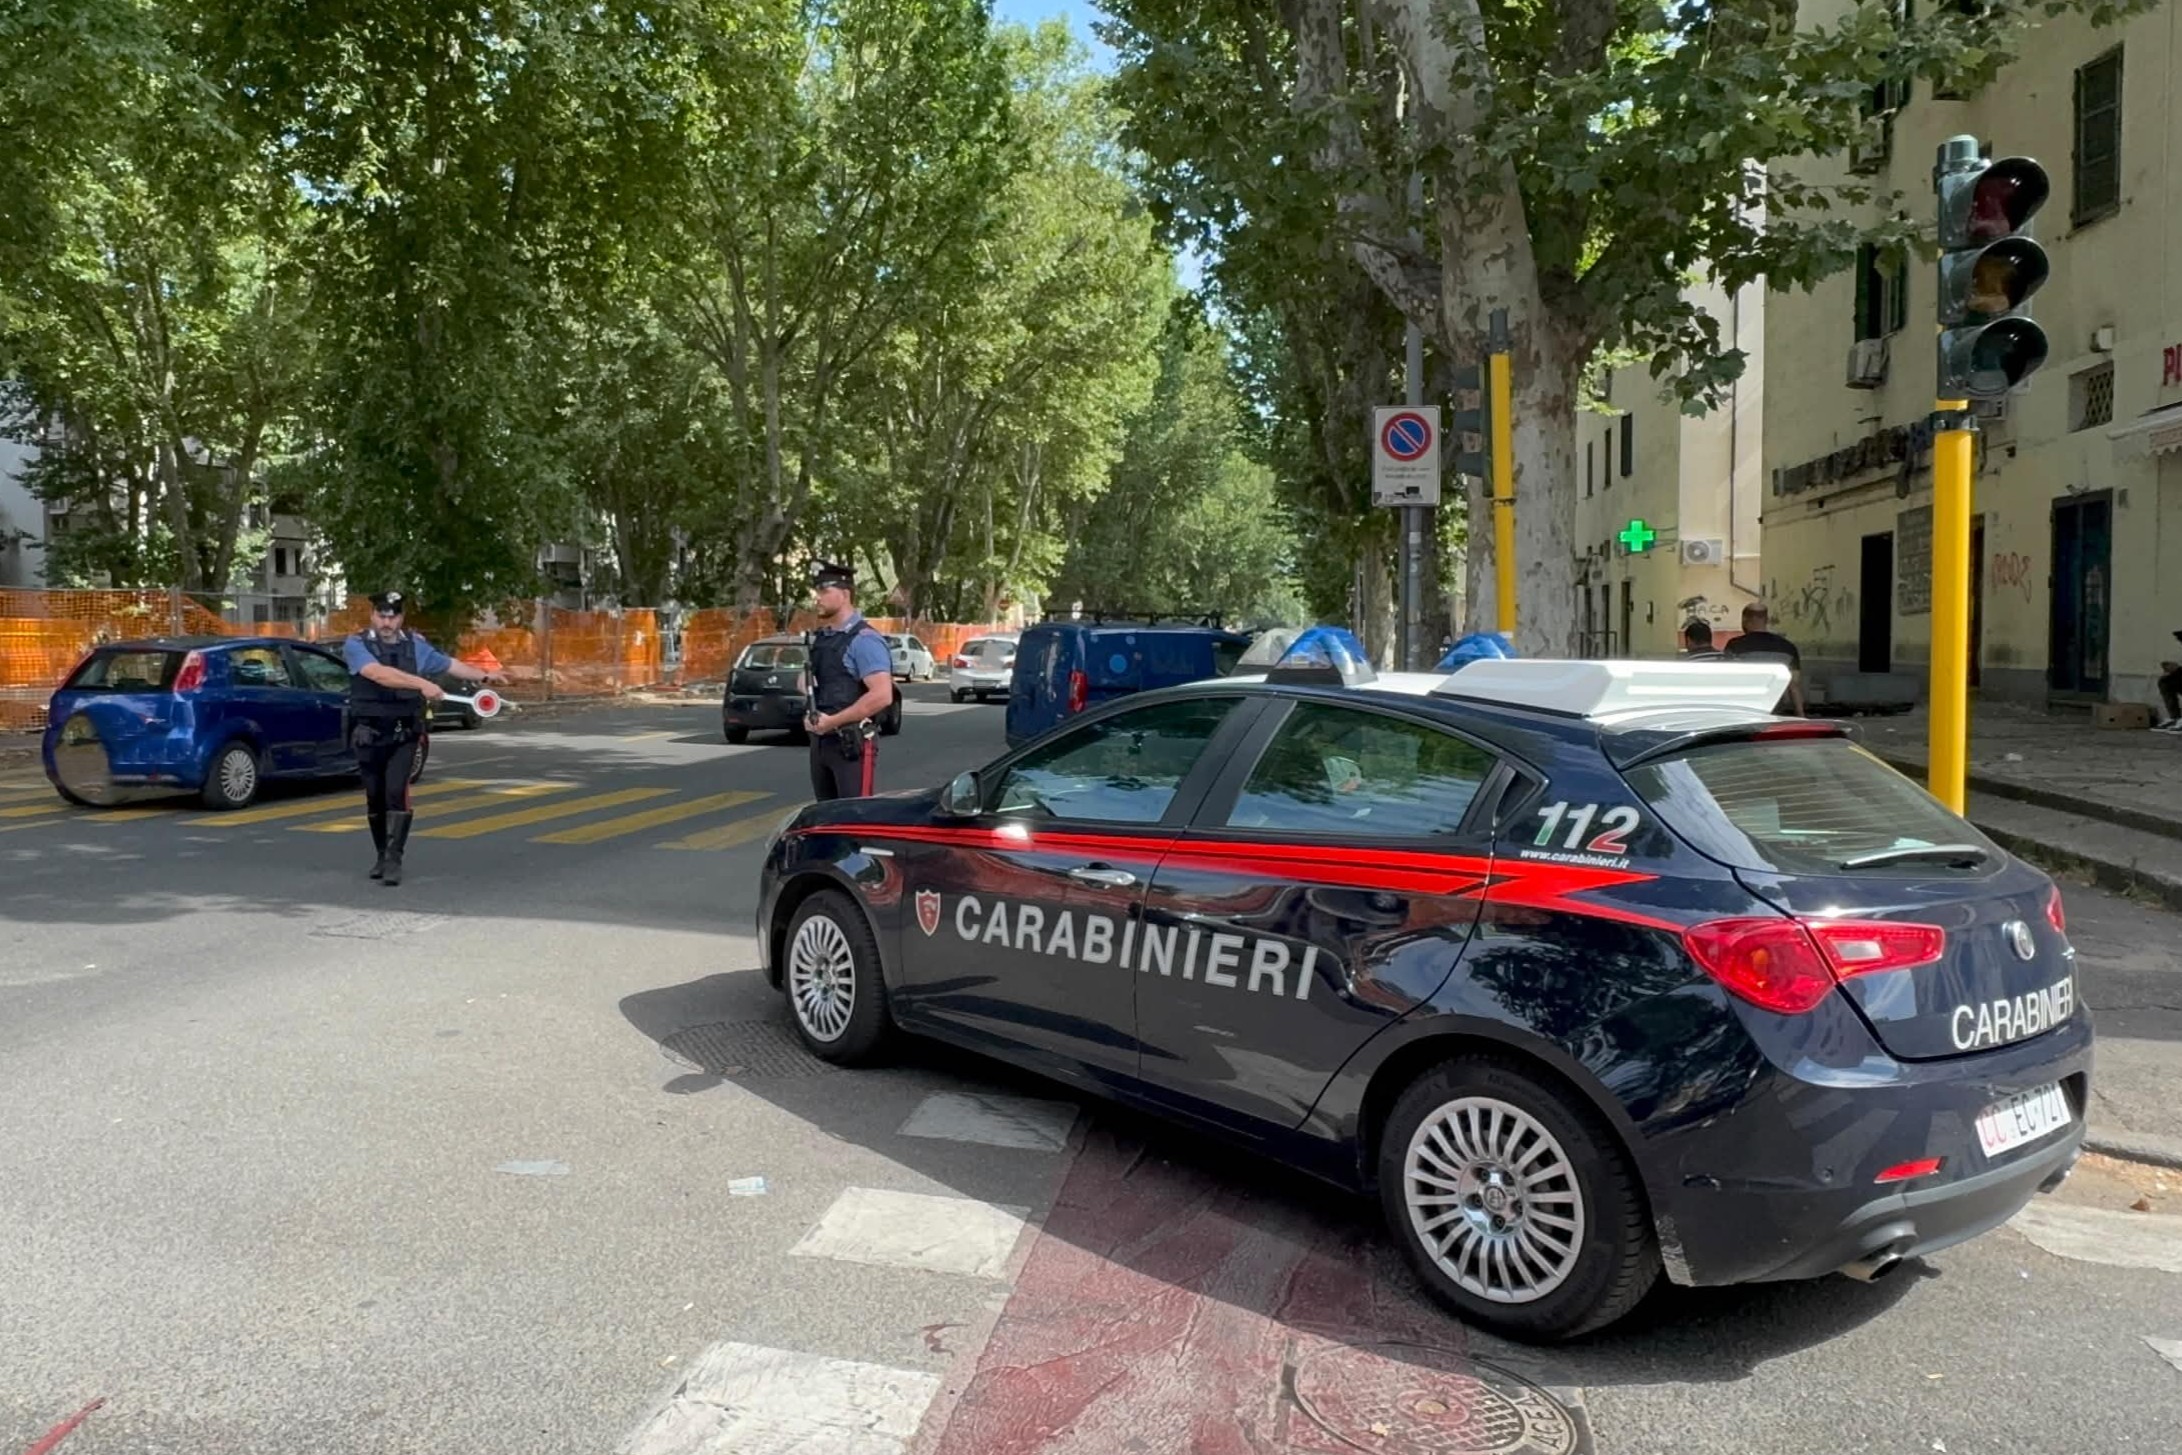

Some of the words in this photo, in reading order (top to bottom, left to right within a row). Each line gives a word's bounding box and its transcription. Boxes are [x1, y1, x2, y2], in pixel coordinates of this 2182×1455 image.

[1533, 801, 1640, 854] 112
[1520, 849, 1630, 869] www.carabinieri.it
[955, 895, 1319, 1000] CARABINIERI
